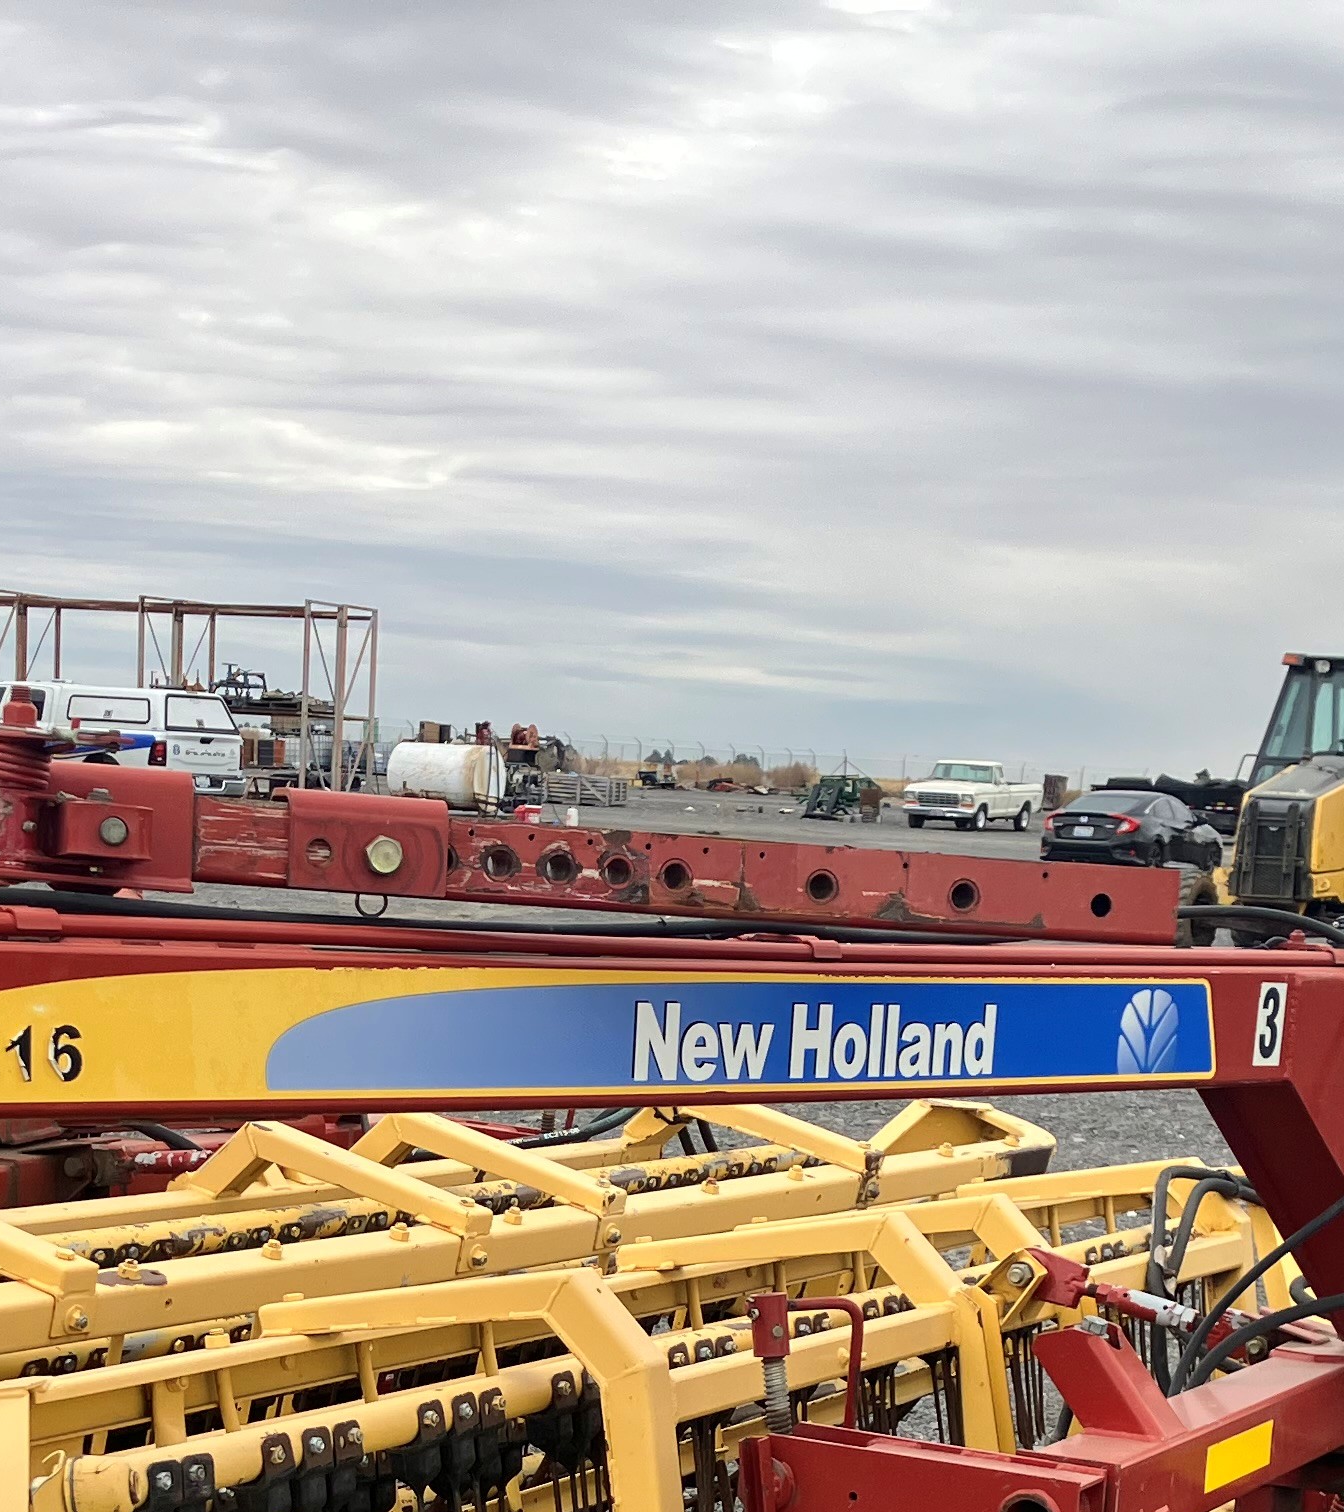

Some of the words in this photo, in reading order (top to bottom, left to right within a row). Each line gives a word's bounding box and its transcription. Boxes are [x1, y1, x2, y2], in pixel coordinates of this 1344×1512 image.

[633, 1000, 775, 1082] New
[789, 1002, 998, 1079] Holland
[1259, 987, 1280, 1059] 3
